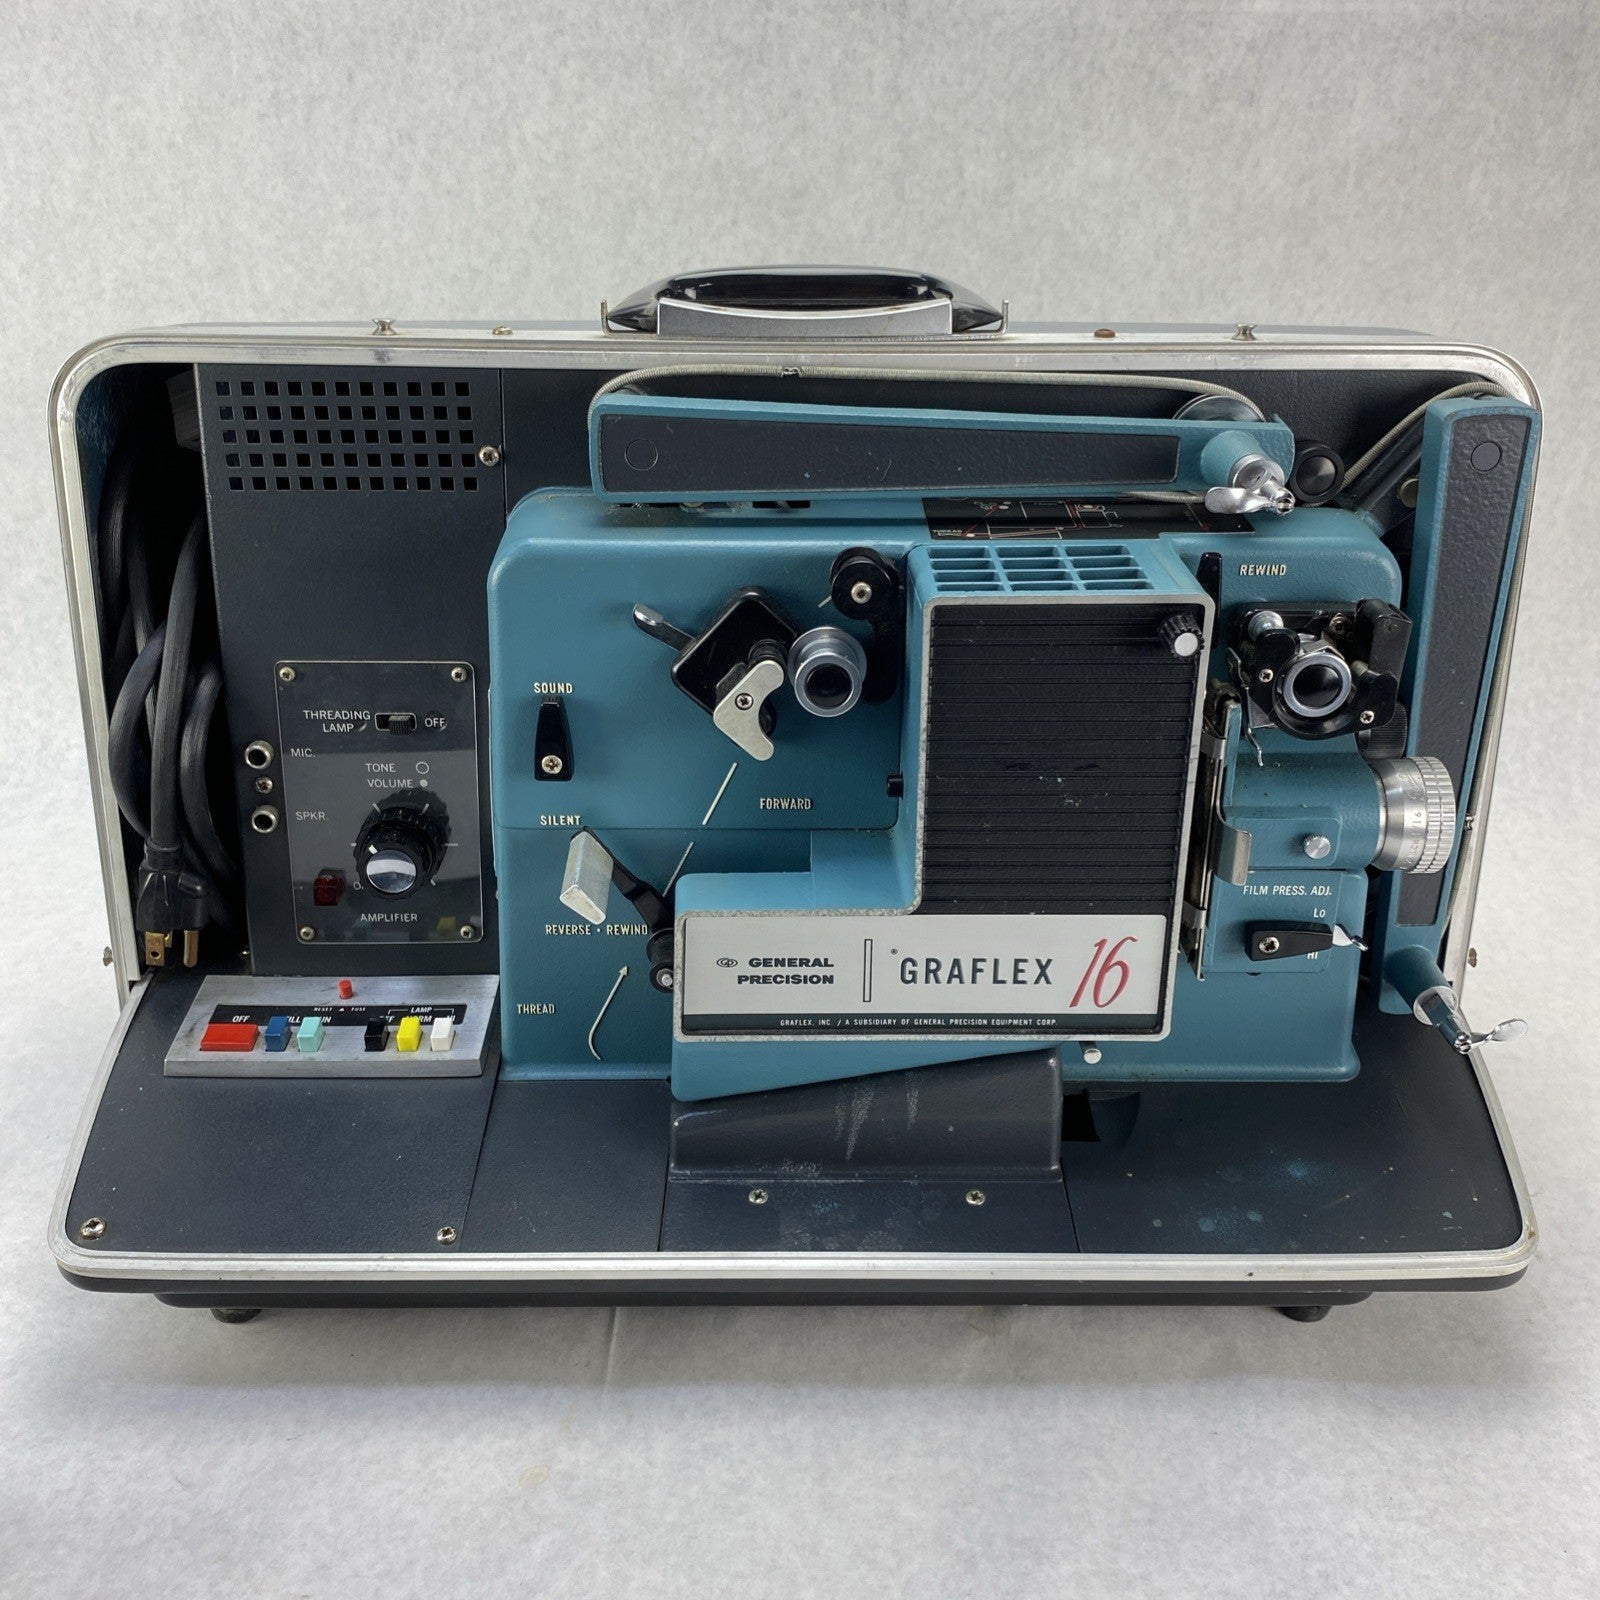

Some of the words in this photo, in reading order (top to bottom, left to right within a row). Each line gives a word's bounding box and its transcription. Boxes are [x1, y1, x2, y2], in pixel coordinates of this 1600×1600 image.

[1239, 564, 1287, 576] REWIND
[533, 682, 573, 695] SOUND
[303, 710, 371, 721] THREADING
[322, 723, 355, 733] LAMP
[424, 718, 446, 728] OFF
[290, 748, 316, 758] MIC.
[365, 763, 396, 773] TONE
[367, 779, 414, 788] VOLUME
[759, 797, 812, 811] FORWARD
[295, 811, 329, 821] SPKR.
[540, 815, 581, 827] SILENT
[1243, 885, 1269, 896] FILM
[1272, 885, 1307, 896] PRESS.
[1310, 885, 1332, 896] ADJ.
[360, 912, 418, 922] AMPLIFIER
[545, 924, 591, 936] REVERSE
[606, 924, 648, 936] REWIND
[749, 957, 834, 968] GENERAL
[900, 957, 1053, 985] GRAFLEX
[1069, 936, 1138, 1008] 16
[737, 974, 834, 985] PRECISION
[410, 1006, 432, 1014] LAMP
[516, 1003, 555, 1015] THREAD
[232, 1015, 251, 1023] OFF
[844, 1018, 850, 1026] A
[853, 1018, 897, 1026] SUBSIDIARY
[901, 1018, 910, 1026] OF
[913, 1018, 946, 1026] GENERAL
[949, 1018, 988, 1026] PRECISION
[991, 1018, 1033, 1026] EQUIPMENT
